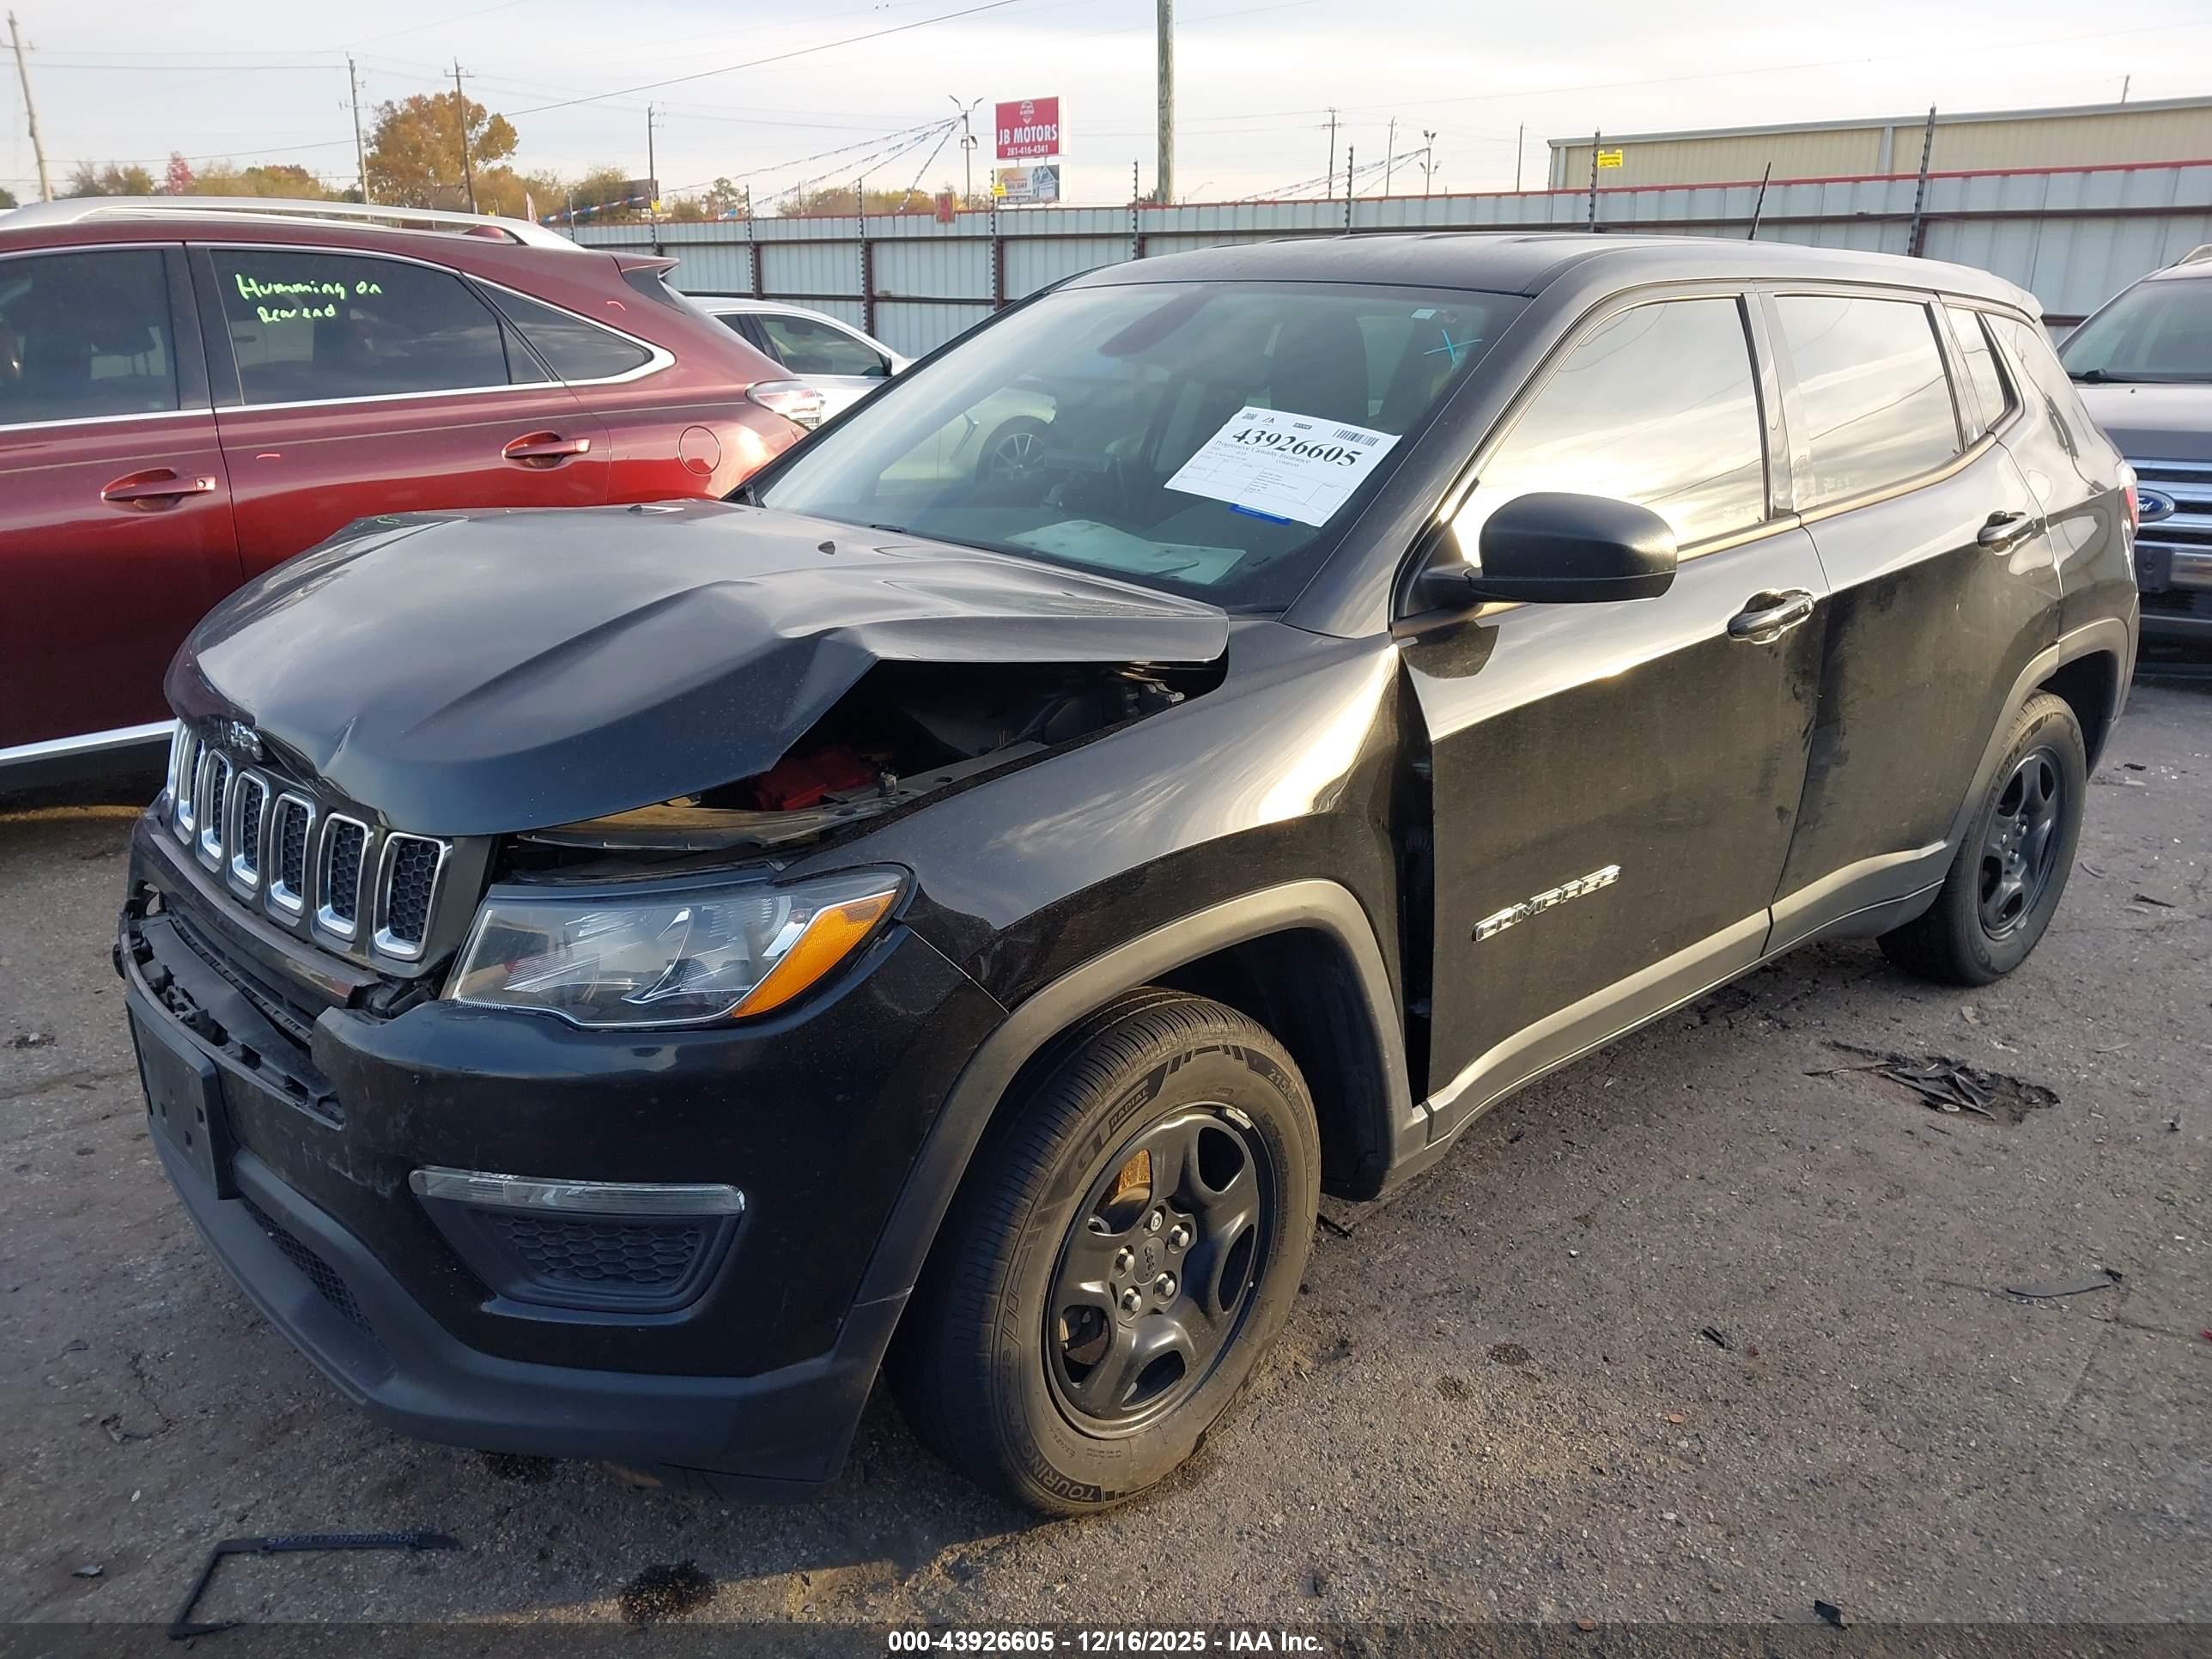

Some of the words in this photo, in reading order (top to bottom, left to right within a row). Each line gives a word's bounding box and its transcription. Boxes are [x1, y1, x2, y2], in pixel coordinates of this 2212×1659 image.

[999, 129, 1011, 145] JB
[1013, 124, 1058, 144] MOTORS
[234, 273, 345, 300] Humming
[302, 303, 336, 319] end
[1215, 440, 1251, 452] Progressive
[1251, 447, 1278, 458] Casualty
[1279, 452, 1311, 464] Insurance
[1232, 428, 1363, 467] 43926605
[1110, 1088, 1149, 1127] RADIAL
[1020, 1443, 1096, 1502] TOURING
